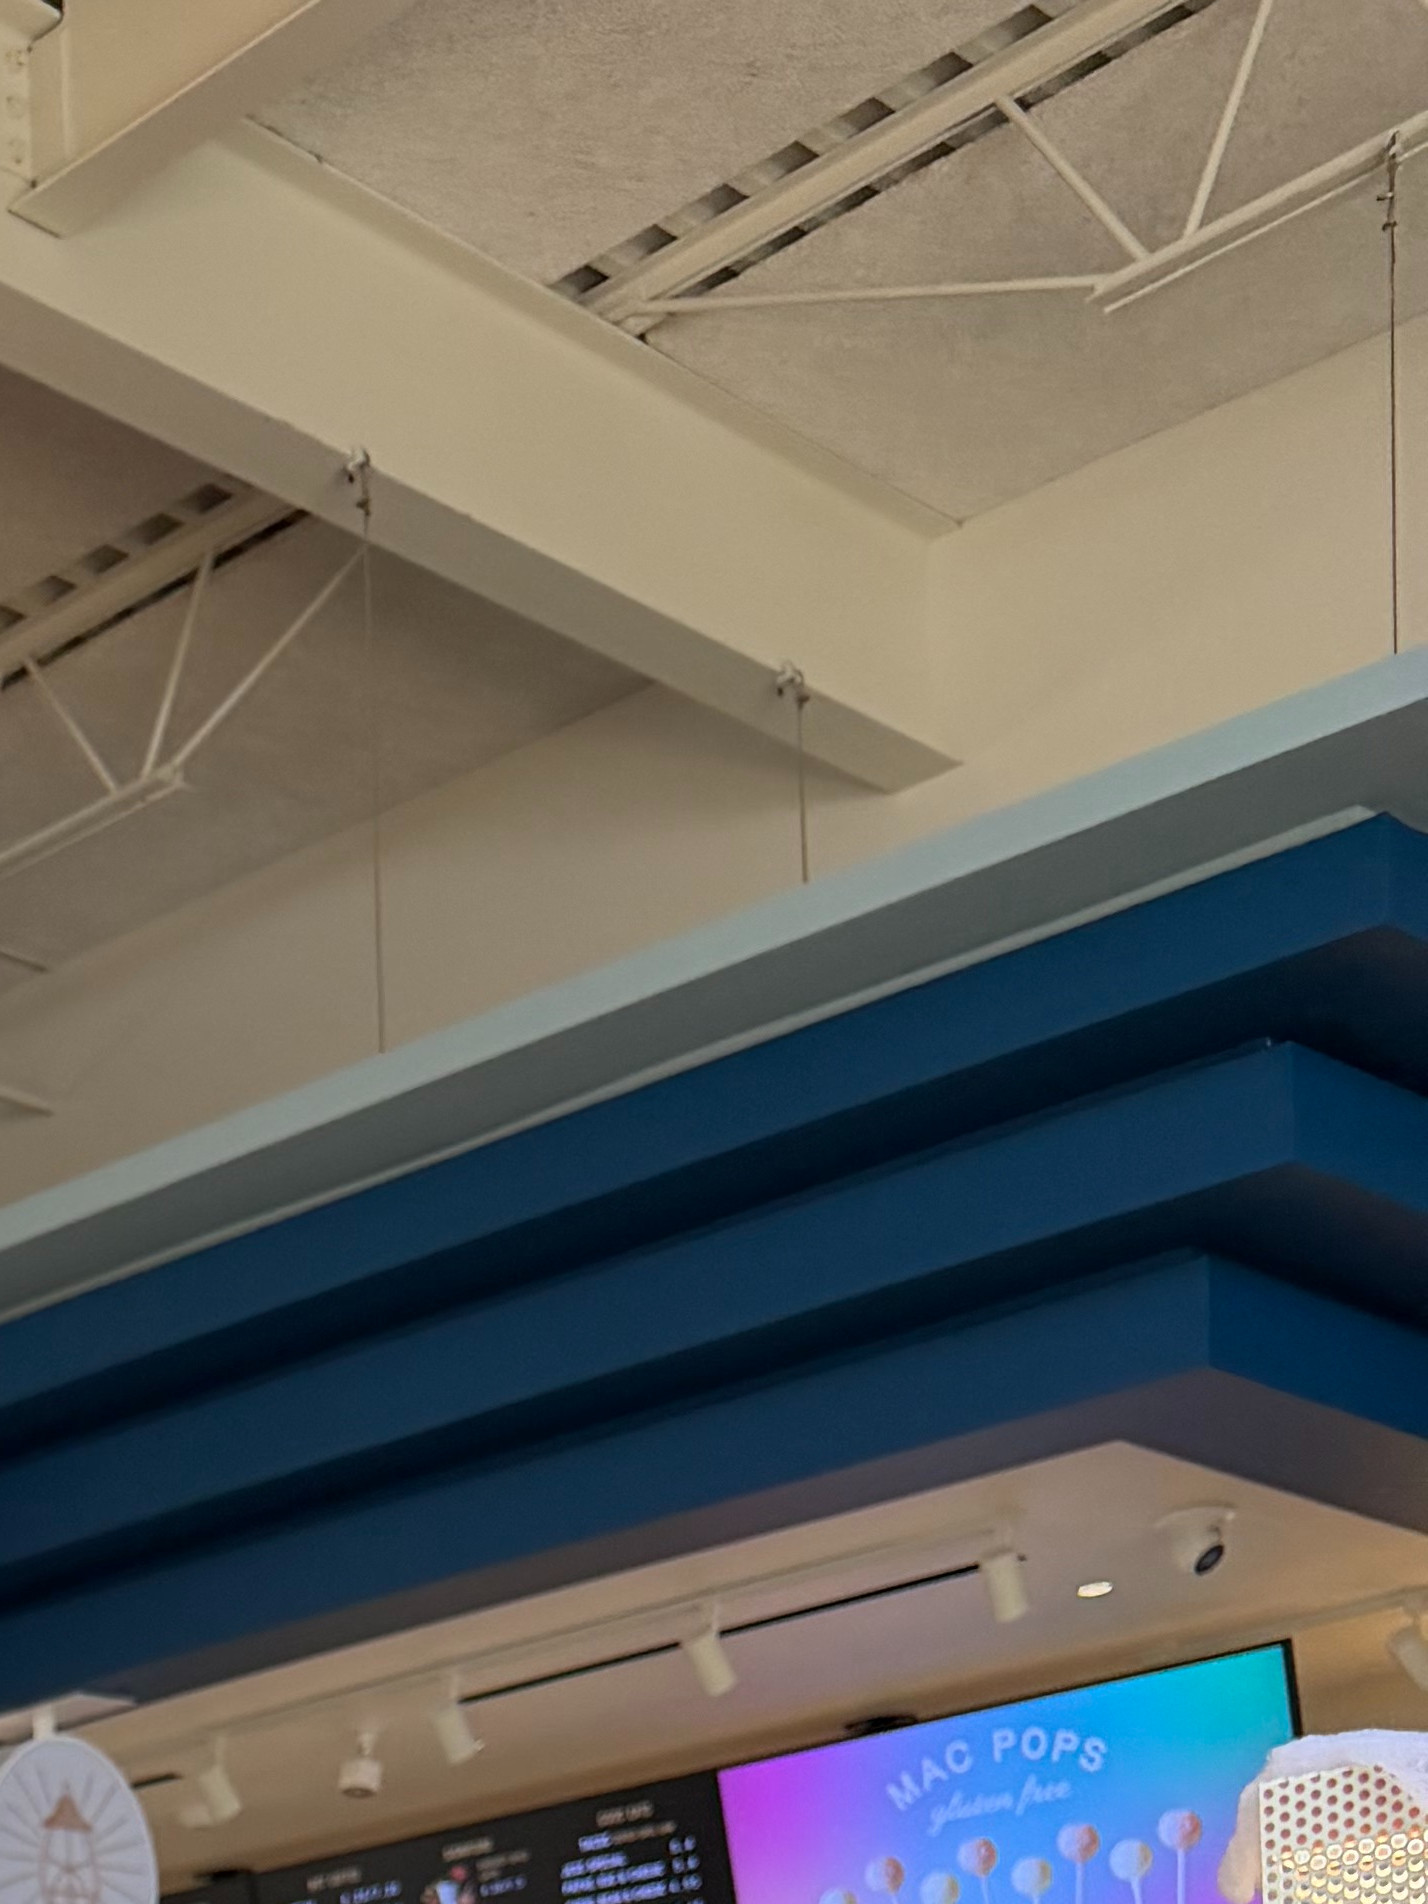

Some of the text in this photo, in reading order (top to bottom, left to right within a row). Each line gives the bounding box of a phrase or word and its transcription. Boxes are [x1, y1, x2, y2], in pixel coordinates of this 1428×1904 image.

[887, 1727, 1109, 1813] MAC POPS
[1015, 1774, 1073, 1821] free
